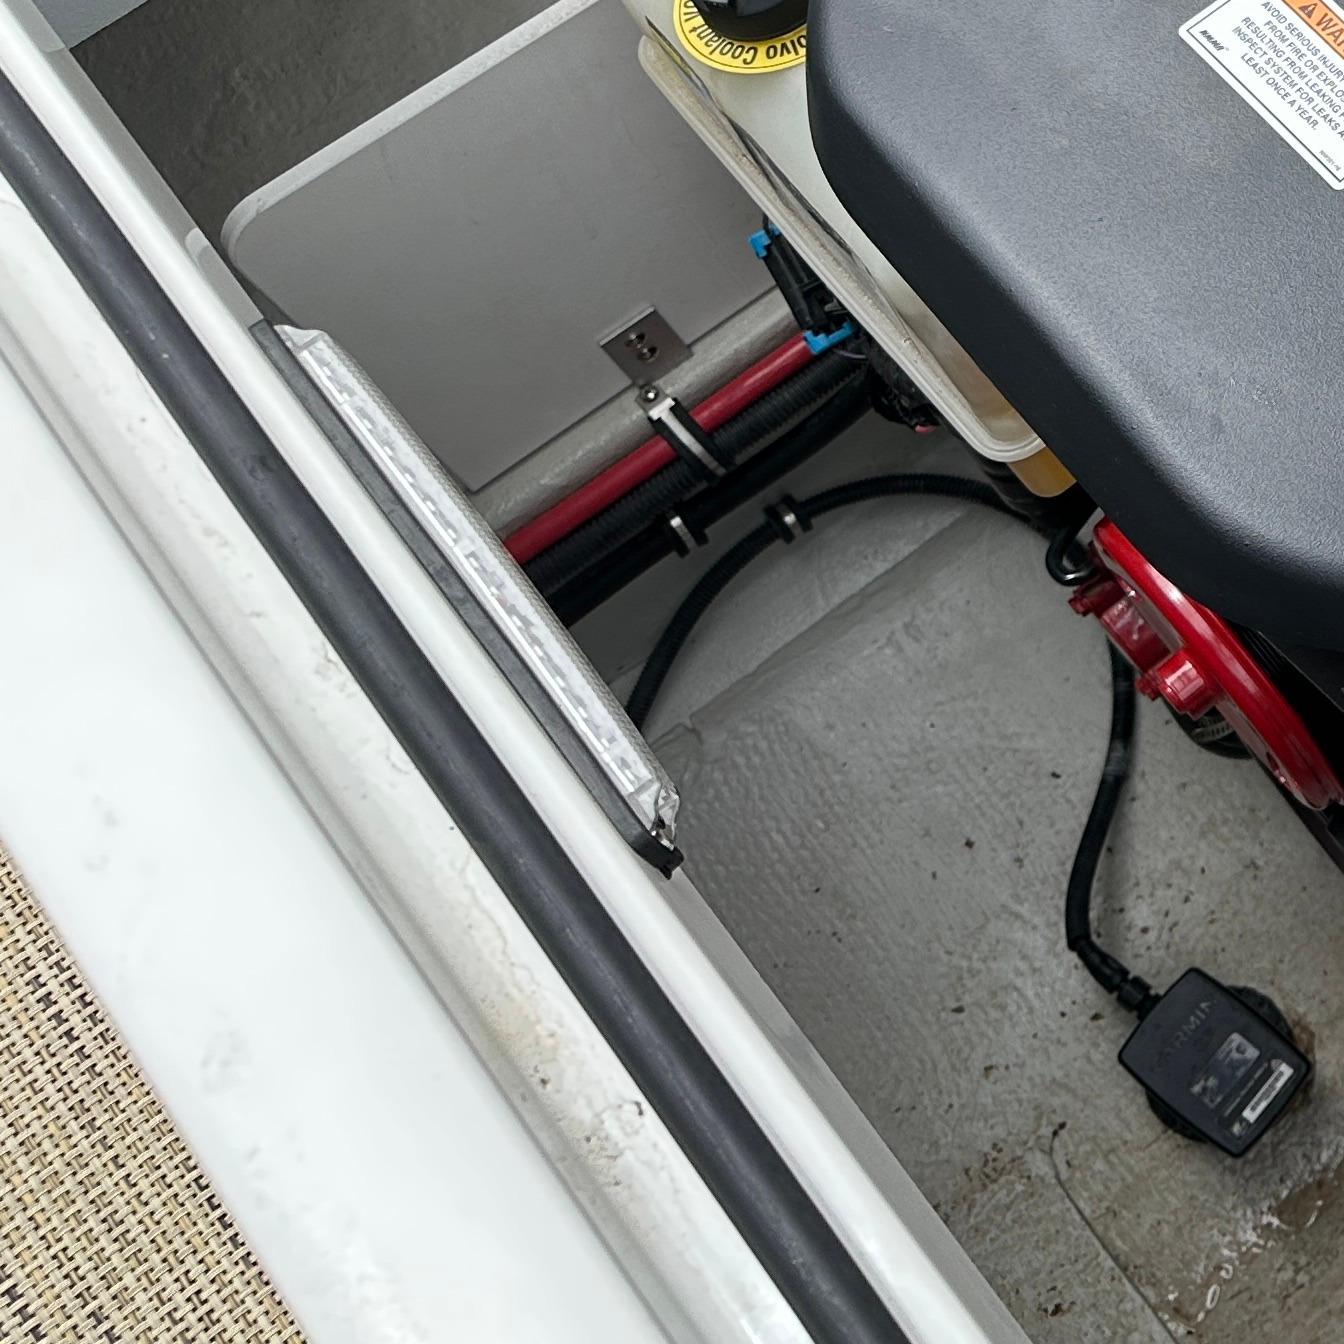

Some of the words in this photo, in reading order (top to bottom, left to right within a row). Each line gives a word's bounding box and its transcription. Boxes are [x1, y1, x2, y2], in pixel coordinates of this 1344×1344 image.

[688, 22, 757, 65] Coolant
[765, 34, 806, 59] olvo
[1239, 15, 1287, 60] RESULTING
[1281, 54, 1309, 82] FROM
[1303, 76, 1343, 114] LEAKING
[1262, 18, 1290, 45] FROM
[1284, 40, 1307, 62] FIRE
[1302, 57, 1320, 75] OR
[1282, 20, 1322, 58] SERIOUS
[1230, 24, 1268, 60] INSPECT
[1262, 55, 1299, 90] SYSTEM
[1293, 85, 1315, 106] FOR
[1309, 101, 1342, 132] LEAKS
[1239, 51, 1269, 80] LEAST
[1263, 74, 1291, 102] ONCE
[1286, 96, 1298, 108] A
